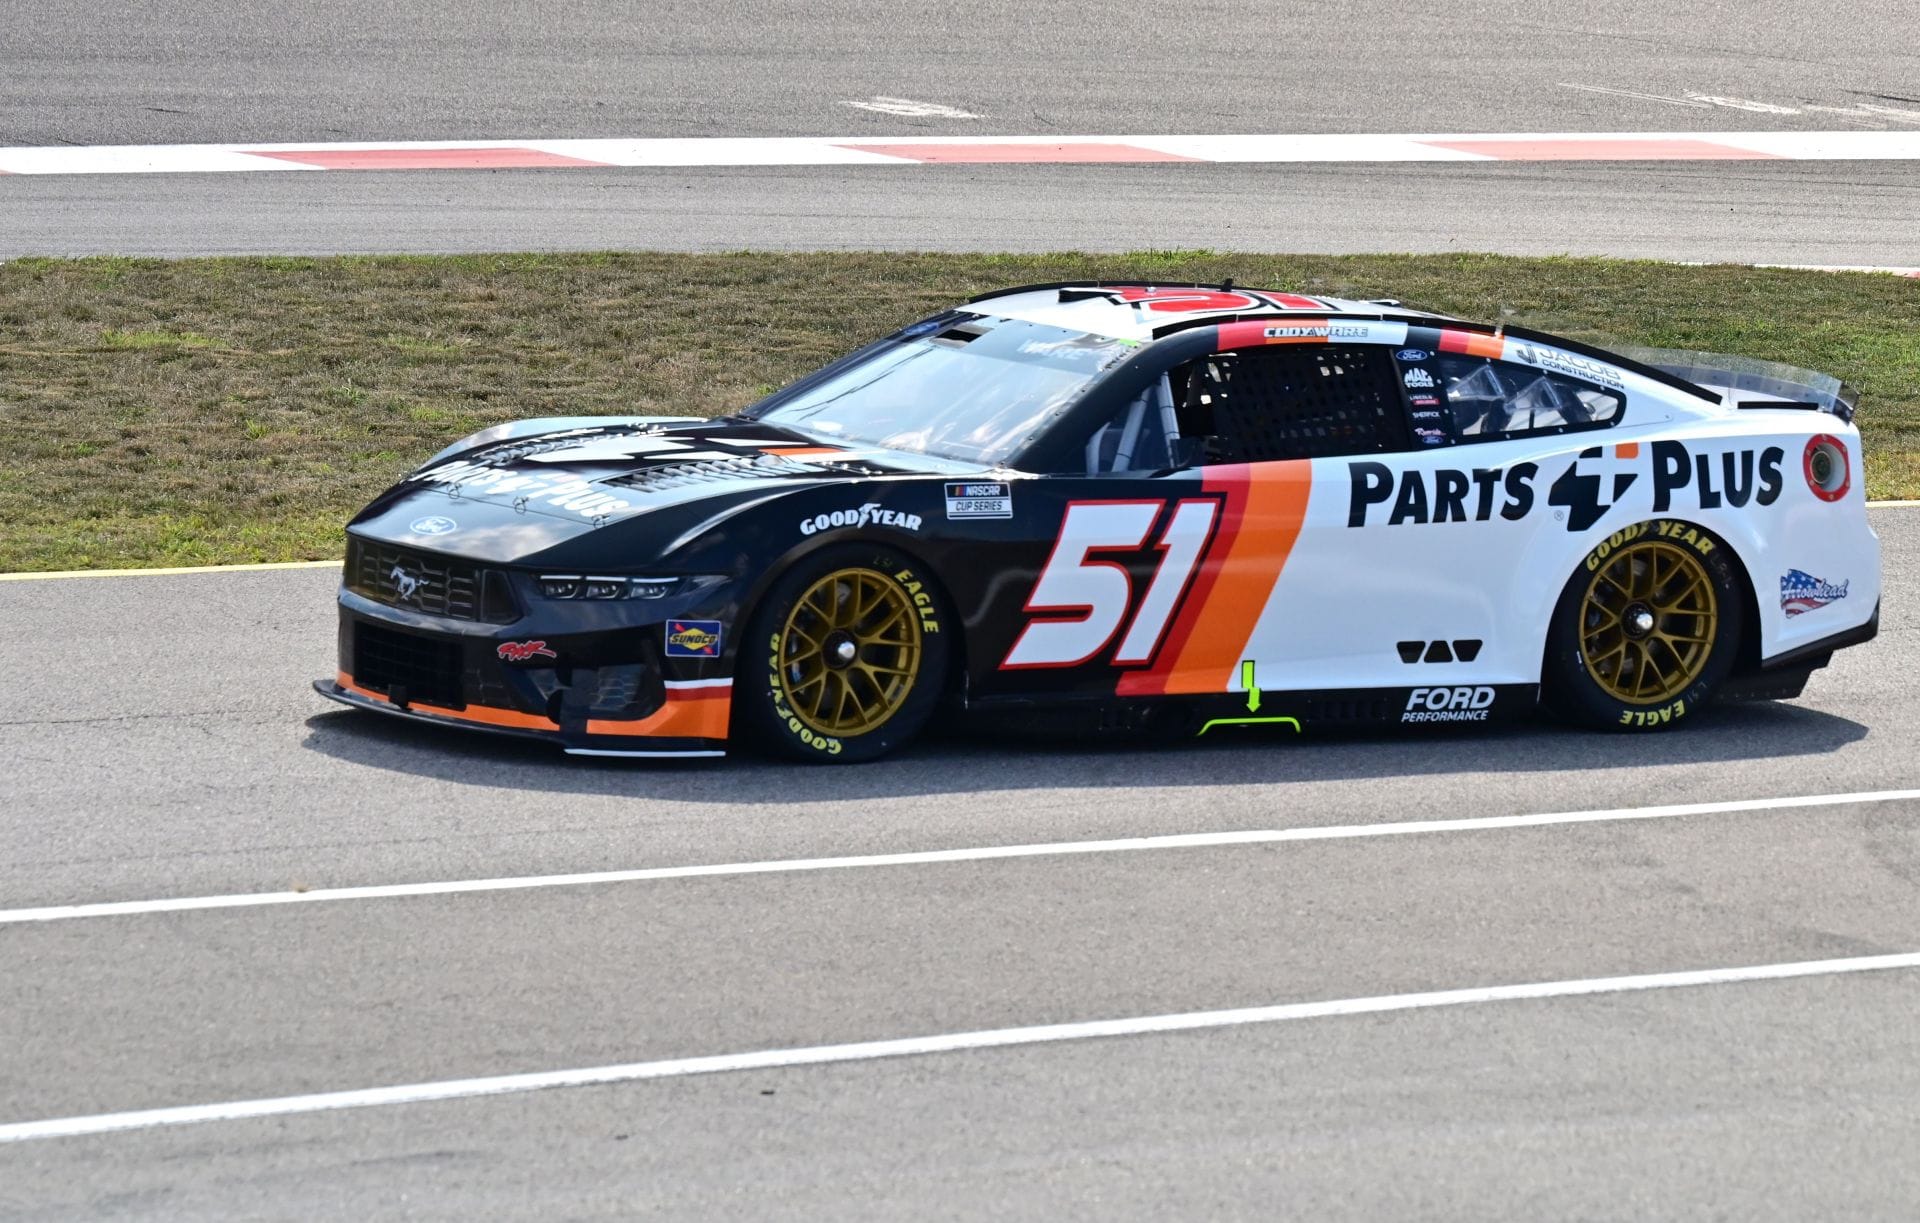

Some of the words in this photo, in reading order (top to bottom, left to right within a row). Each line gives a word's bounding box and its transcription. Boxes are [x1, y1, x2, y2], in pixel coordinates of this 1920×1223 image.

[1263, 326, 1315, 338] CODY
[1315, 326, 1369, 338] WARE
[1404, 367, 1433, 382] MAC
[1540, 348, 1622, 380] JACOB
[1542, 359, 1625, 390] CONSTRUCTION
[965, 485, 1001, 496] NASCAR
[1348, 461, 1539, 528] PARTS
[1651, 440, 1785, 512] PLUS
[955, 501, 973, 512] CUP
[973, 501, 1003, 511] SERIES
[1000, 498, 1222, 670] 51
[894, 569, 939, 633] EAGLE
[669, 634, 718, 645] SUNOCO
[1405, 686, 1496, 711] FORD
[1401, 710, 1489, 722] PERFORMANCE
[1619, 699, 1685, 726] EAGLE
